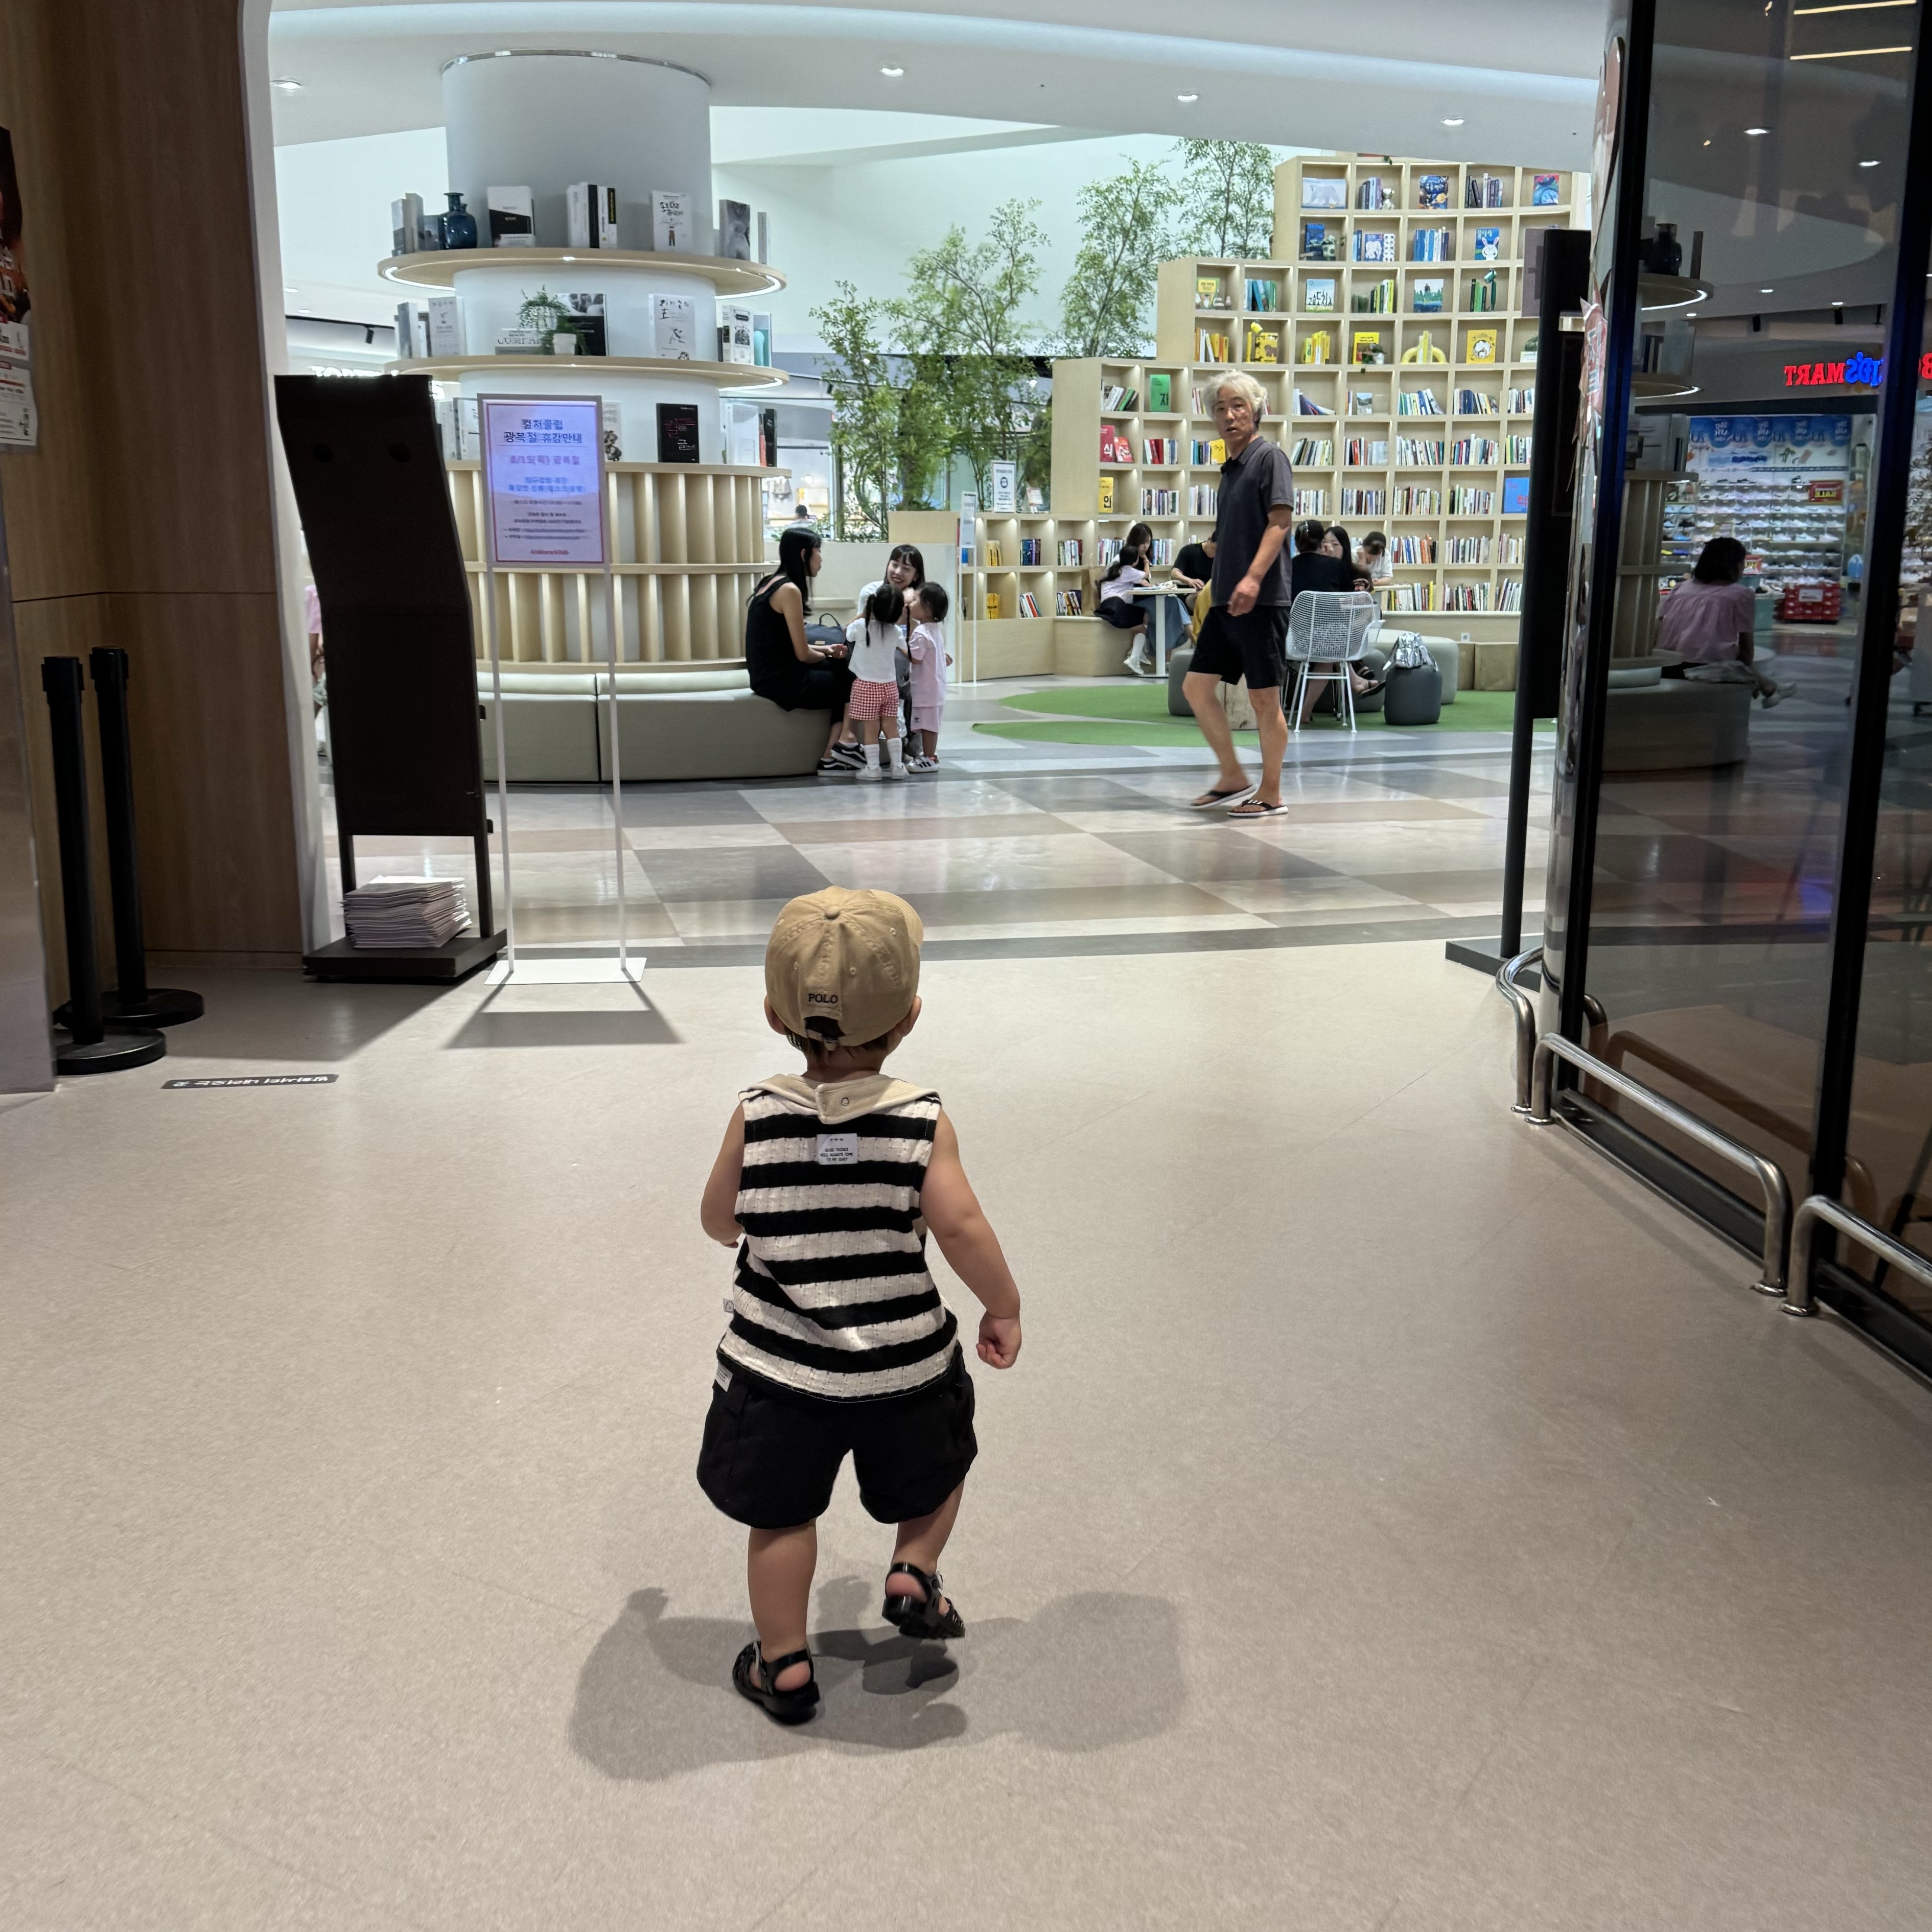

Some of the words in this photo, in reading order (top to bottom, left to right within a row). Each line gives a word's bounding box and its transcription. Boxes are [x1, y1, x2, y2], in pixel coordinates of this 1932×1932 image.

[504, 431, 537, 443] 광복절
[542, 432, 582, 444] 휴강안내
[808, 993, 838, 1004] POLO
